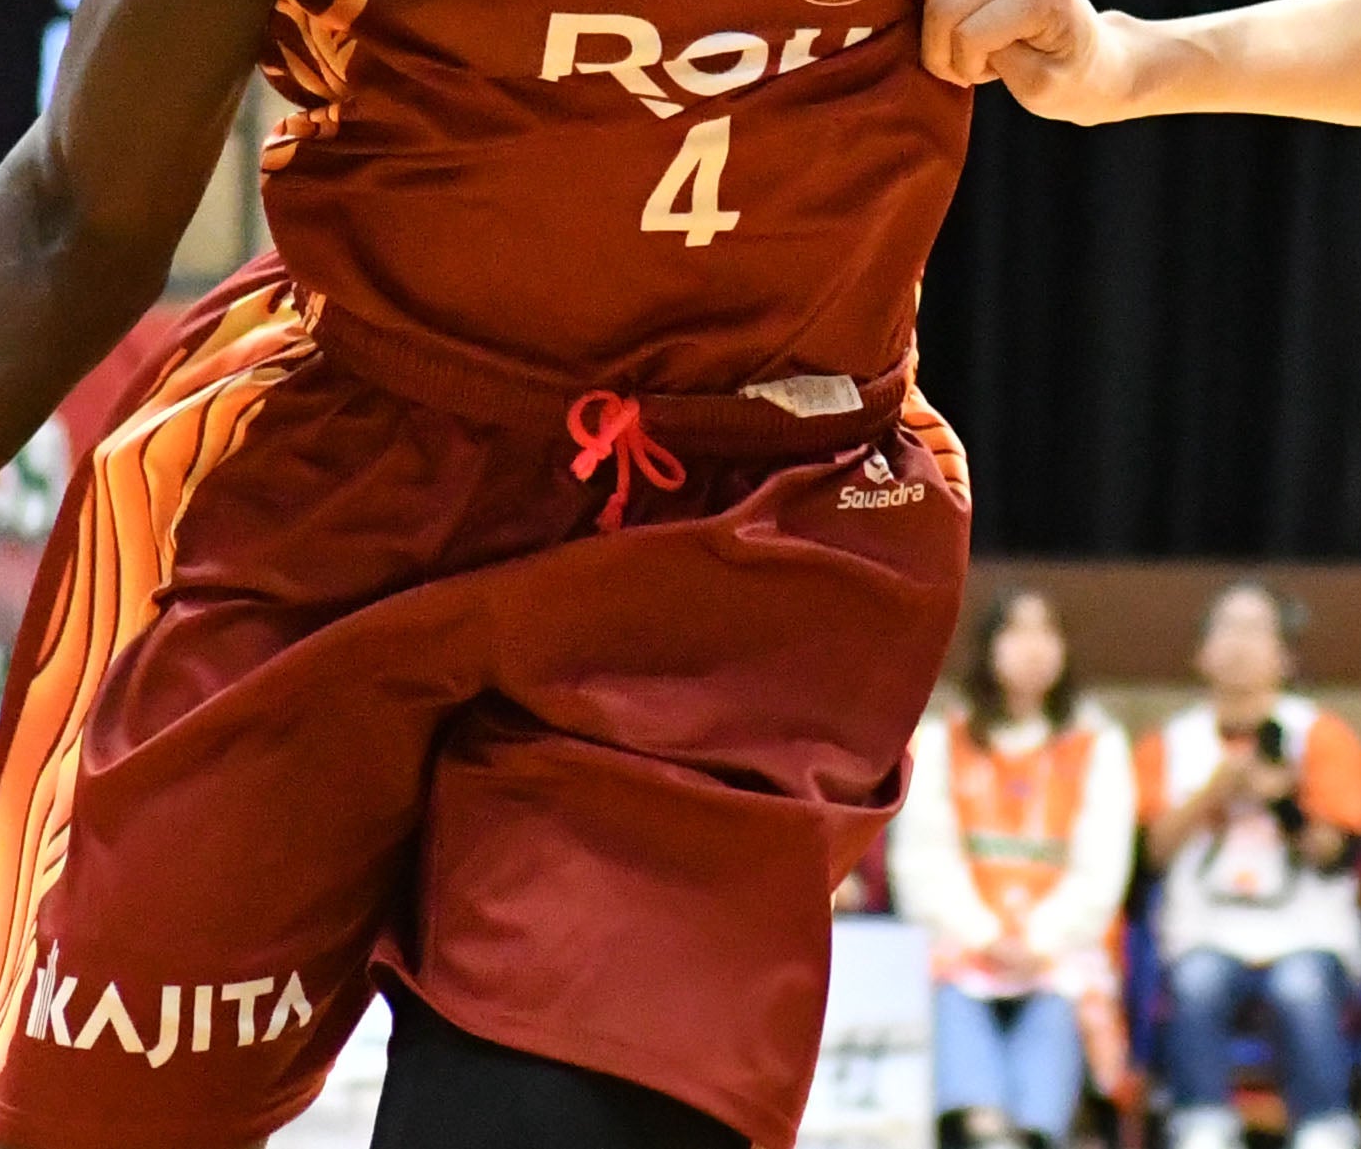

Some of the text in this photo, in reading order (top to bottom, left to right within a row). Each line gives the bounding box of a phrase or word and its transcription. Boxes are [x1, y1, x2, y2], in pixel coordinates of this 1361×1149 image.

[640, 115, 741, 248] 4
[837, 483, 925, 509] Squadra
[25, 938, 313, 1069] KAJITA
